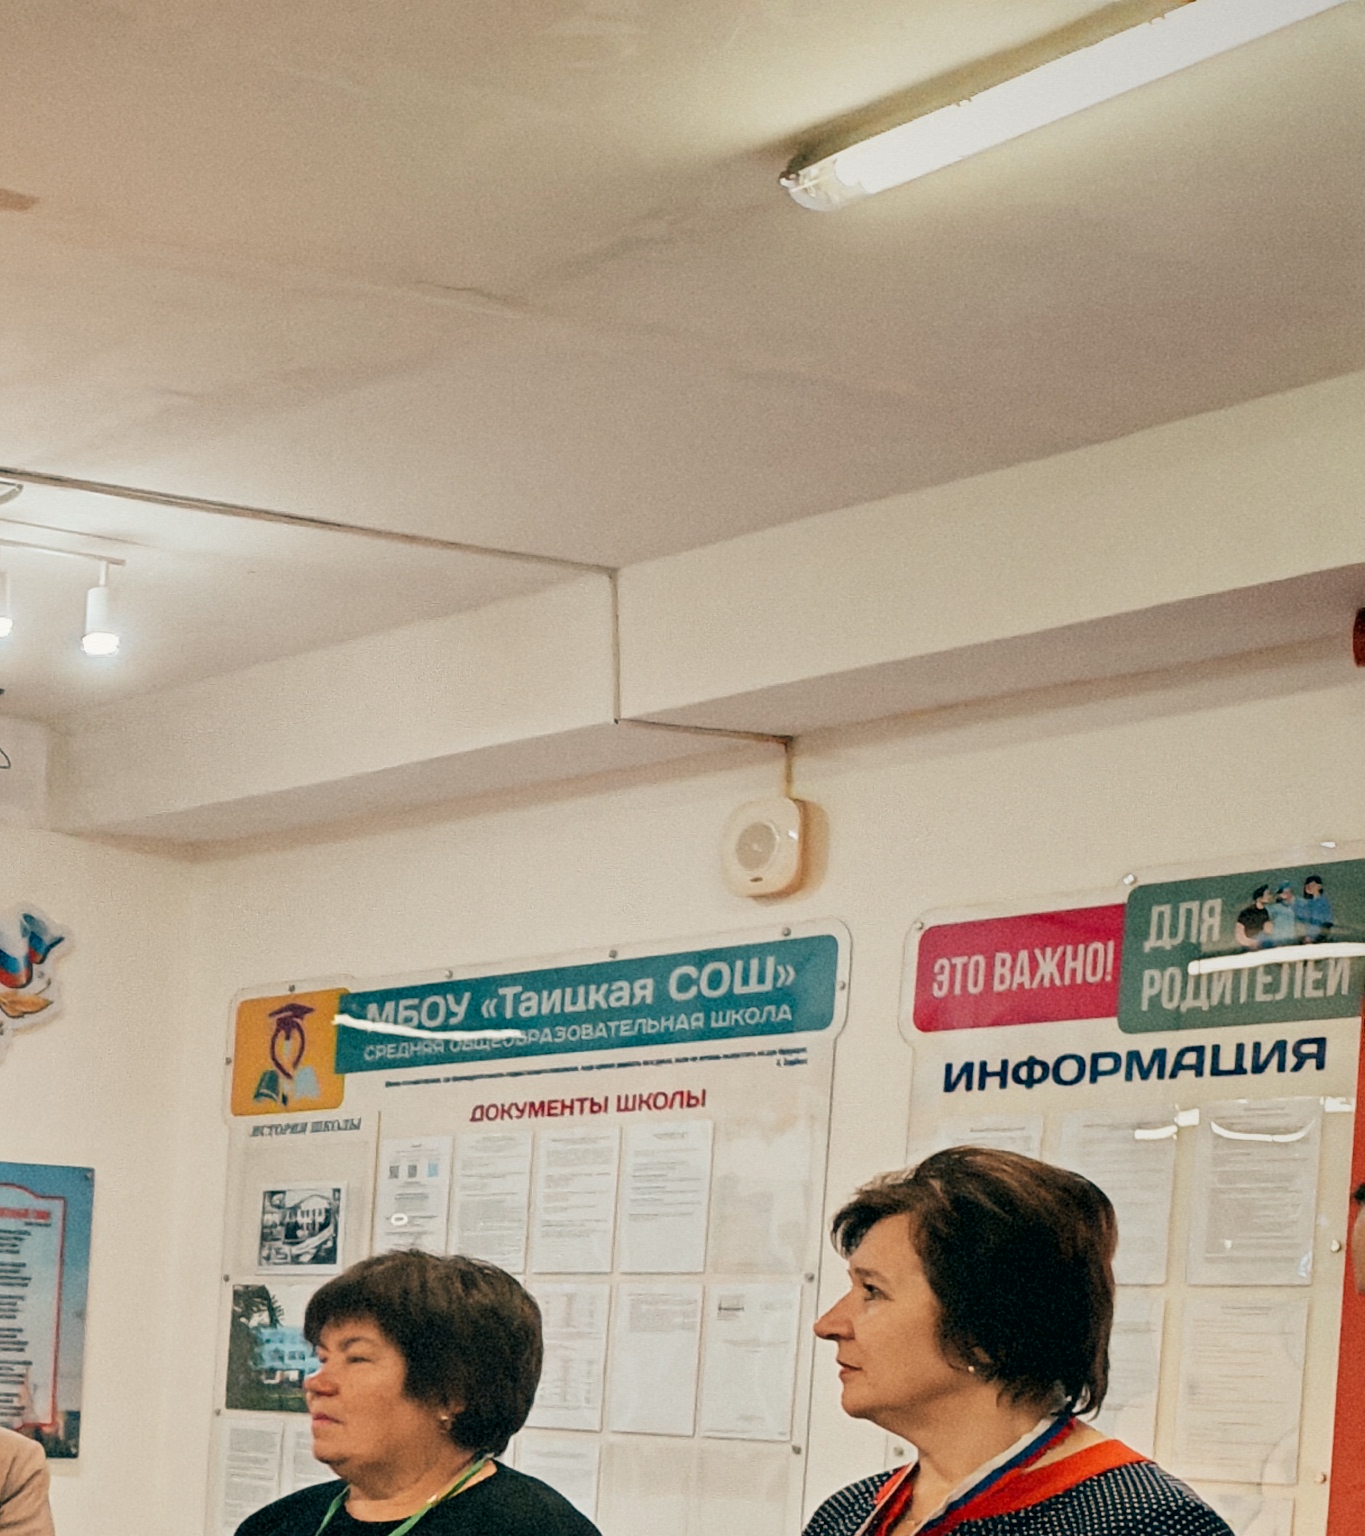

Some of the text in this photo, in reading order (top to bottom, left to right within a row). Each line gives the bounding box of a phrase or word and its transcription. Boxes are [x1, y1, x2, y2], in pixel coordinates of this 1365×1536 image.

[1143, 899, 1222, 952] ДЛЯ
[366, 956, 796, 1028] МБОУ «Таицкая СОШ»
[932, 940, 1114, 998] ЭТО ВАЖНО!
[364, 1005, 793, 1061] СРЕДНЯЯ ОБЩЕОБРАЗОВАТЕЛЬНАЯ ШКОЛА
[943, 1037, 1327, 1093] ИНФОРМАЦИЯ
[469, 1088, 707, 1122] ДОКУМЕНТЫ ШКОЛЫ
